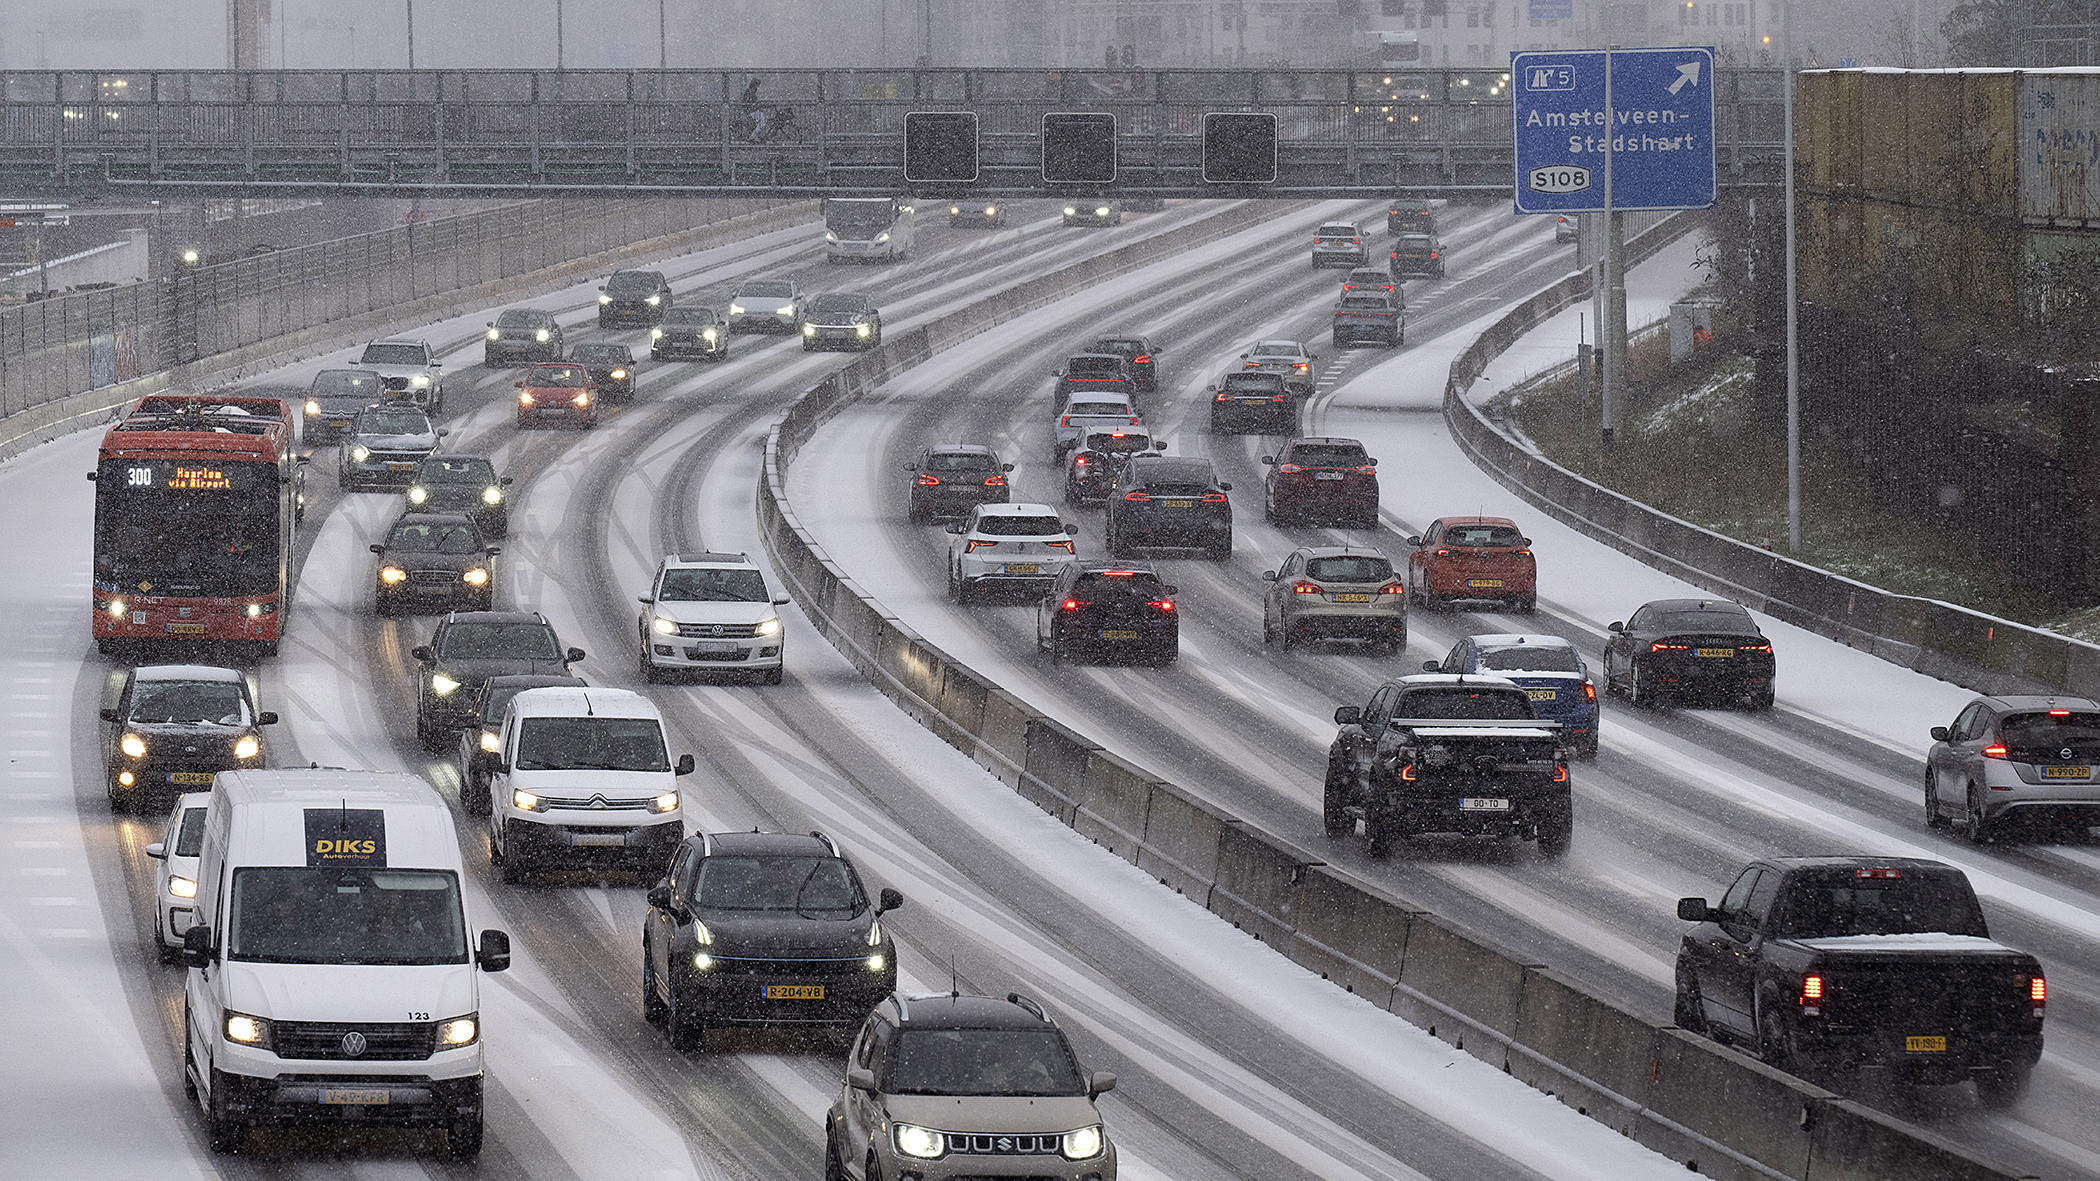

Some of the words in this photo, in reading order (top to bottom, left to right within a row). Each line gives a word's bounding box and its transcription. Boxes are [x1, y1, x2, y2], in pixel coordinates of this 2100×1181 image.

[1558, 71, 1570, 85] 5
[1526, 107, 1690, 127] Amstelveen-
[1568, 132, 1694, 153] Stadshart
[1535, 171, 1586, 187] S108
[128, 467, 152, 486] 300
[177, 466, 222, 479] Haarlem
[168, 479, 186, 488] via
[189, 478, 231, 489] Airport
[174, 773, 210, 782] N-134-XS
[316, 839, 376, 854] DIKS
[770, 987, 821, 997] R-204-VB
[407, 1012, 430, 1020] 123
[328, 1091, 385, 1102] V-49-KFR
